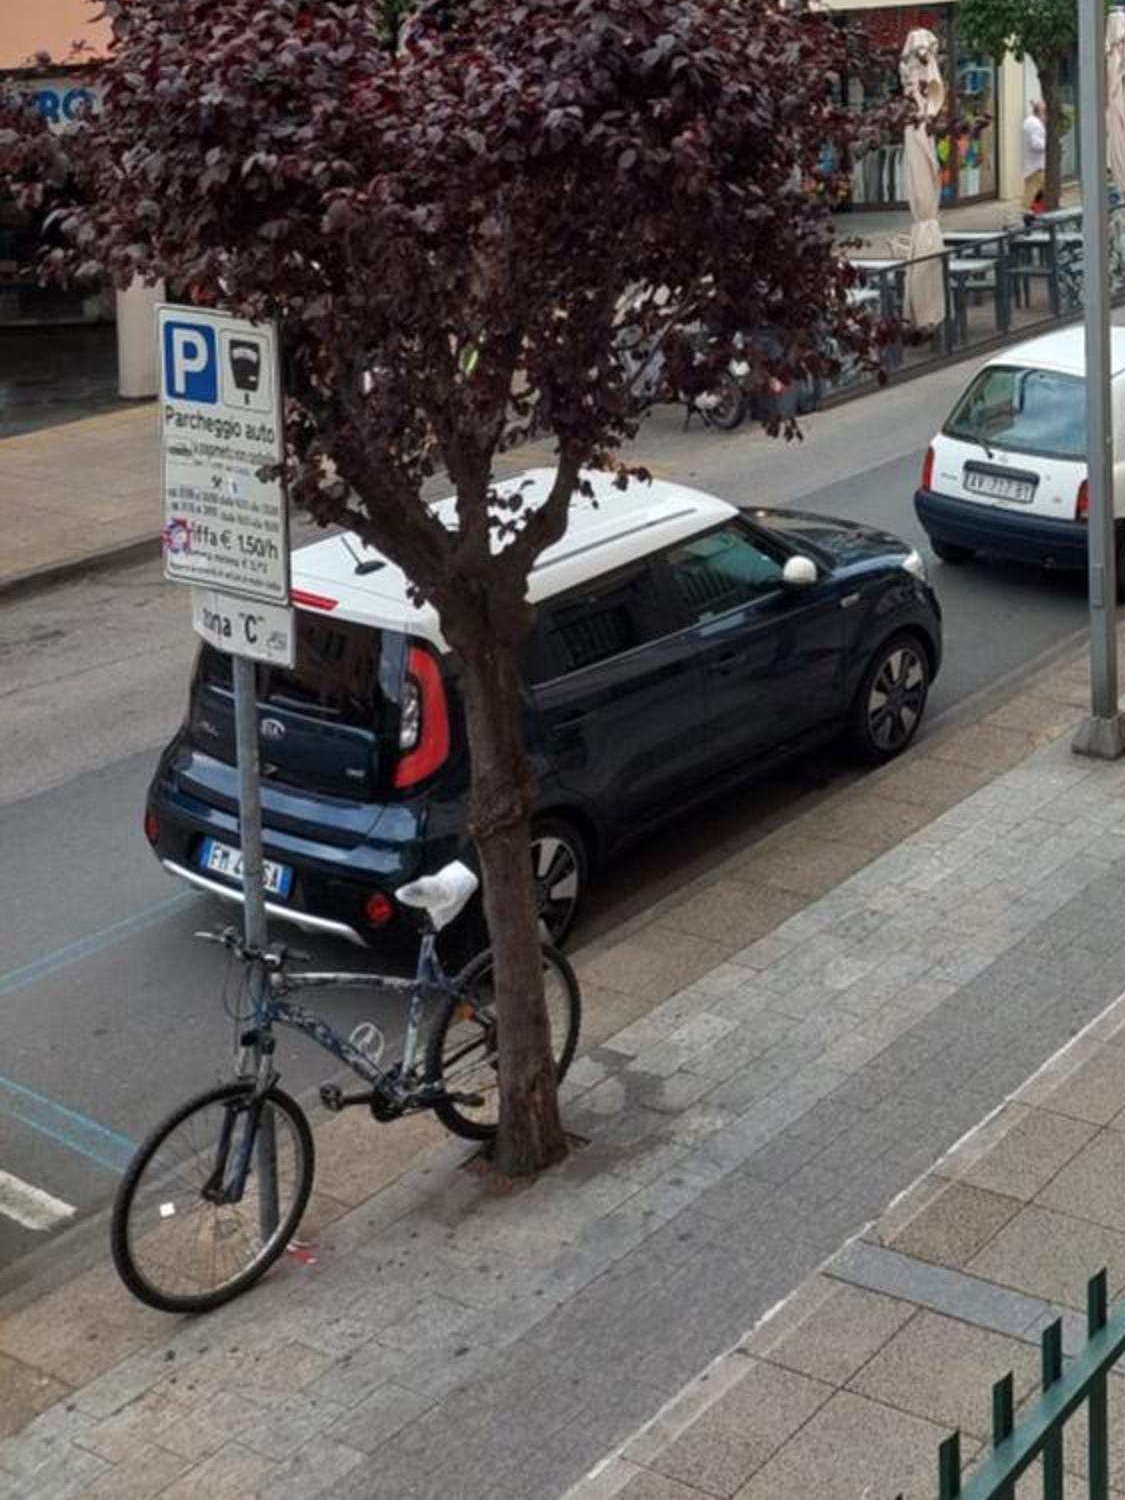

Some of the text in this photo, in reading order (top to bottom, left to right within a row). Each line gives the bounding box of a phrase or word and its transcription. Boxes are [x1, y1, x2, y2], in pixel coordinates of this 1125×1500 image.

[172, 327, 208, 394] P
[164, 404, 275, 444] Parcheggio auto
[220, 529, 232, 551] €
